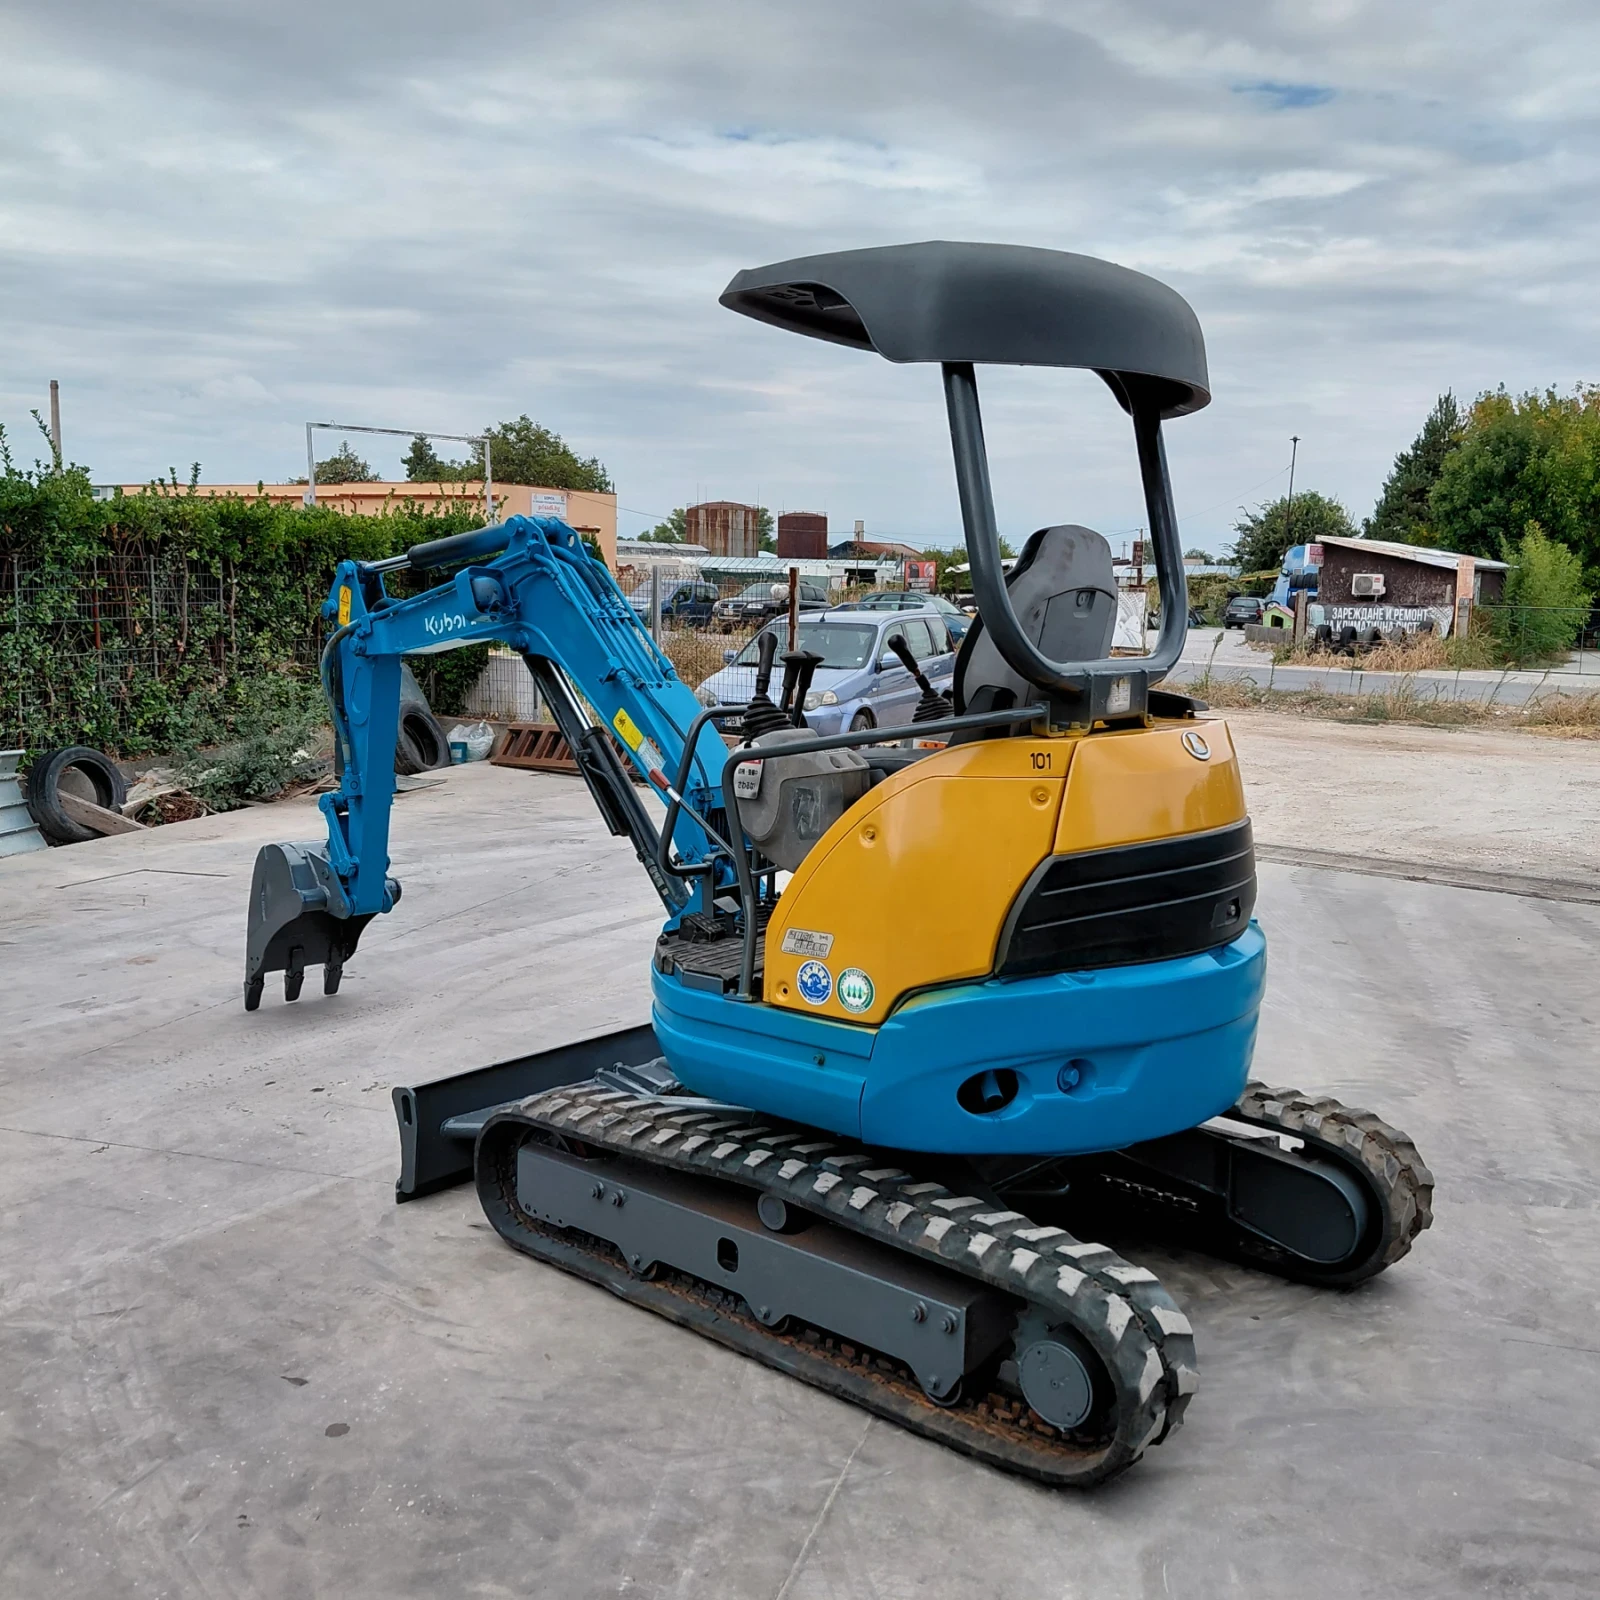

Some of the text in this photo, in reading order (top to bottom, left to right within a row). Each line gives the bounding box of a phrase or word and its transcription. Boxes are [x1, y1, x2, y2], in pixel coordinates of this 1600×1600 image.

[1331, 607, 1428, 621] ЗАРЕЖДАНЕ И РЕМОНТ
[1030, 752, 1052, 770] 101
